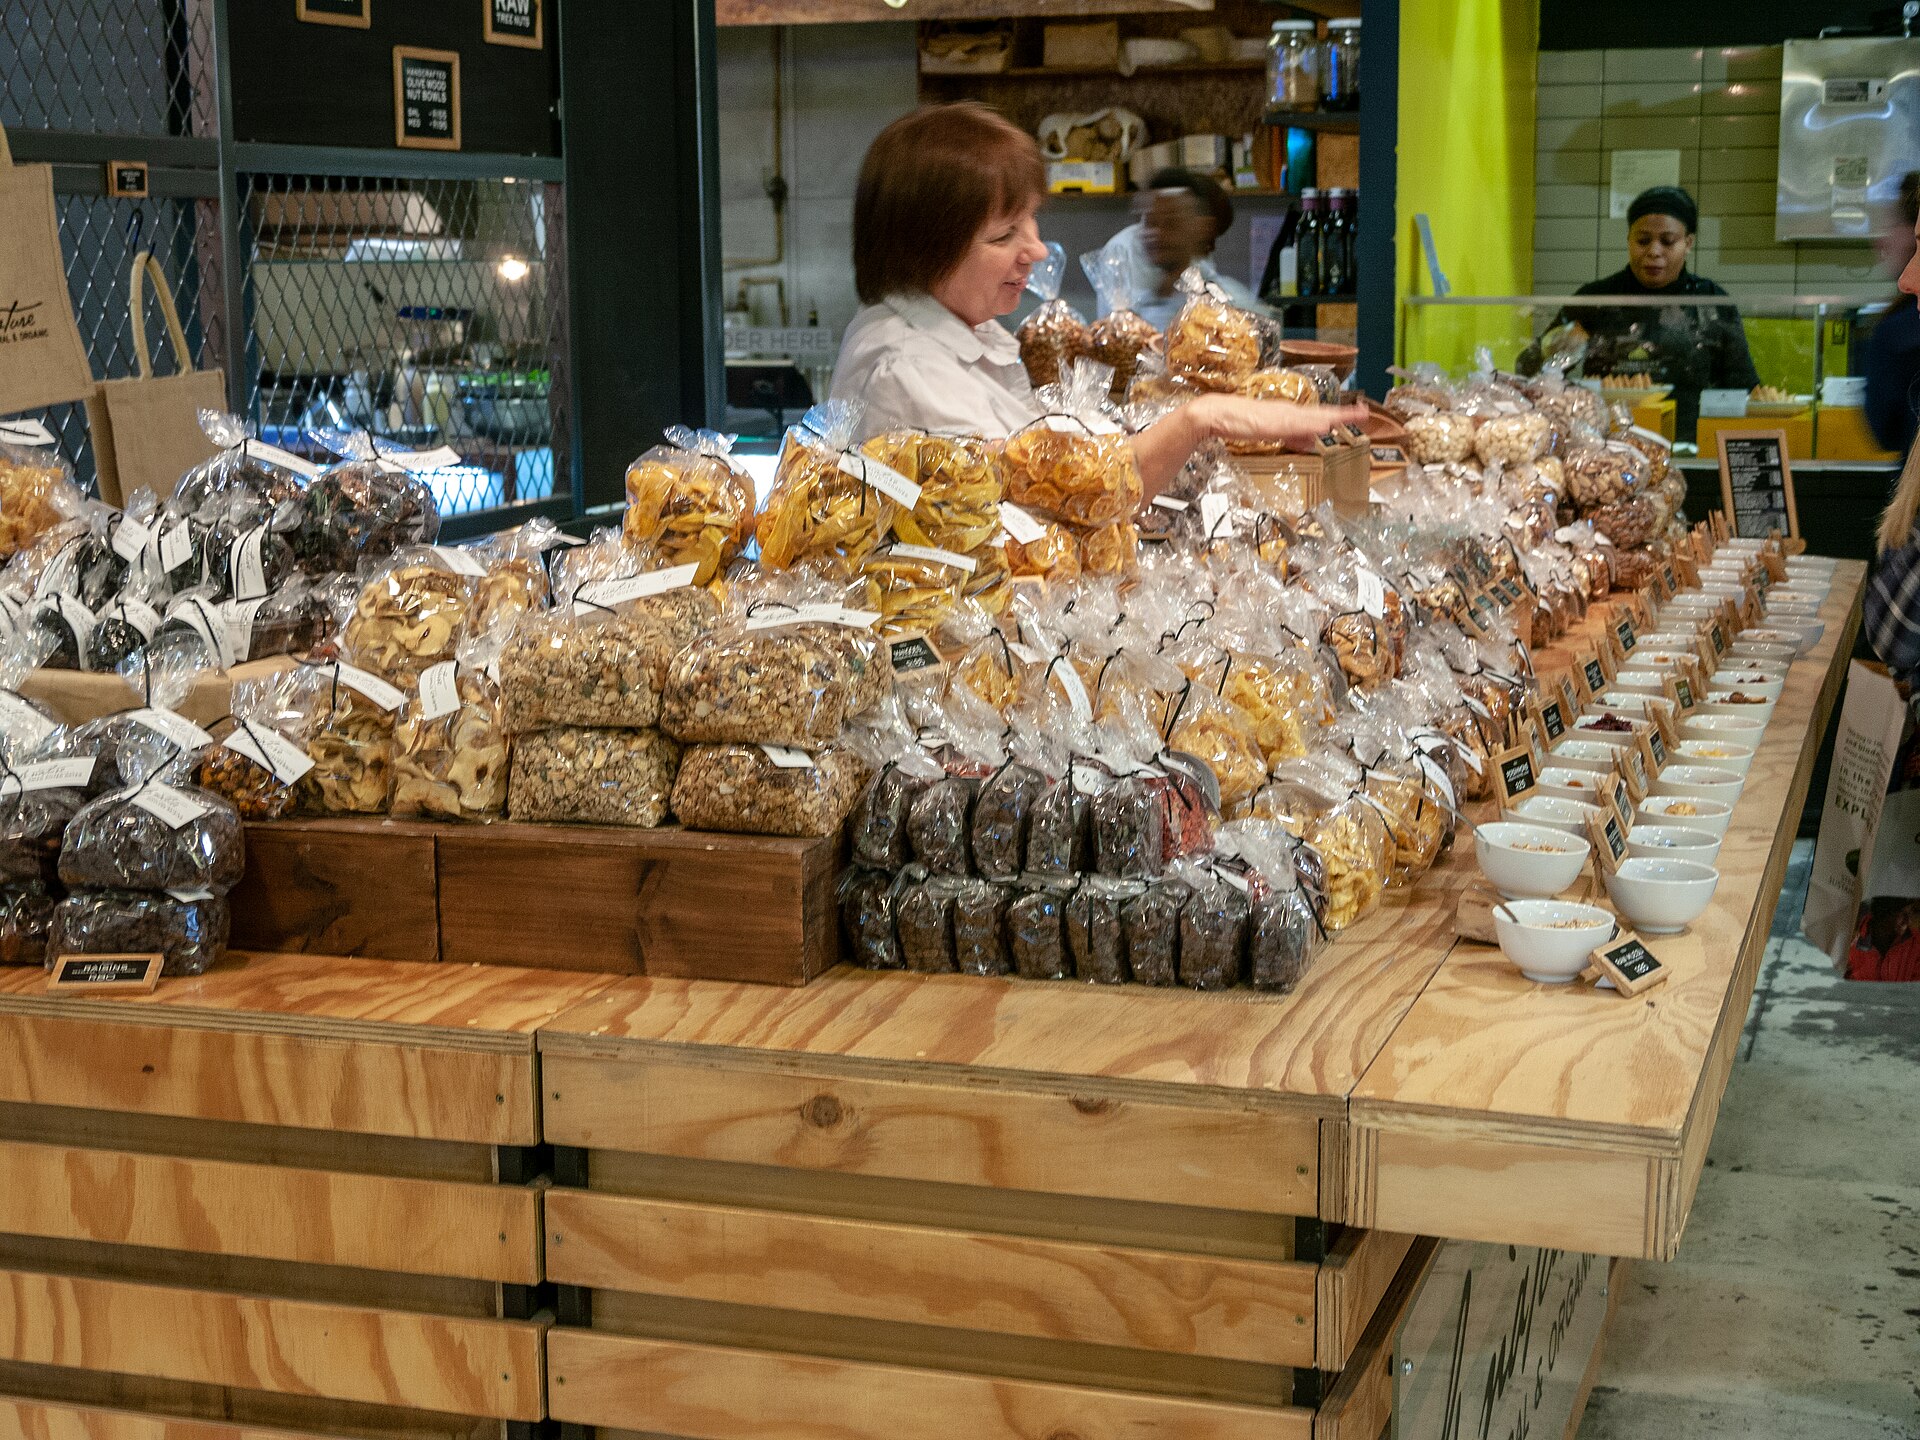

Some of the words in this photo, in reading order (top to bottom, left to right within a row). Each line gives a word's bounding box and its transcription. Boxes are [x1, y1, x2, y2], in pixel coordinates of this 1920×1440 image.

[495, 0, 530, 15] RAW
[406, 66, 447, 80] HANDCRAFTED
[406, 77, 425, 90] OLIVE
[426, 80, 447, 92] WOOD
[406, 88, 421, 101] NUT
[422, 90, 447, 104] BOWLS
[770, 331, 830, 350] HERE
